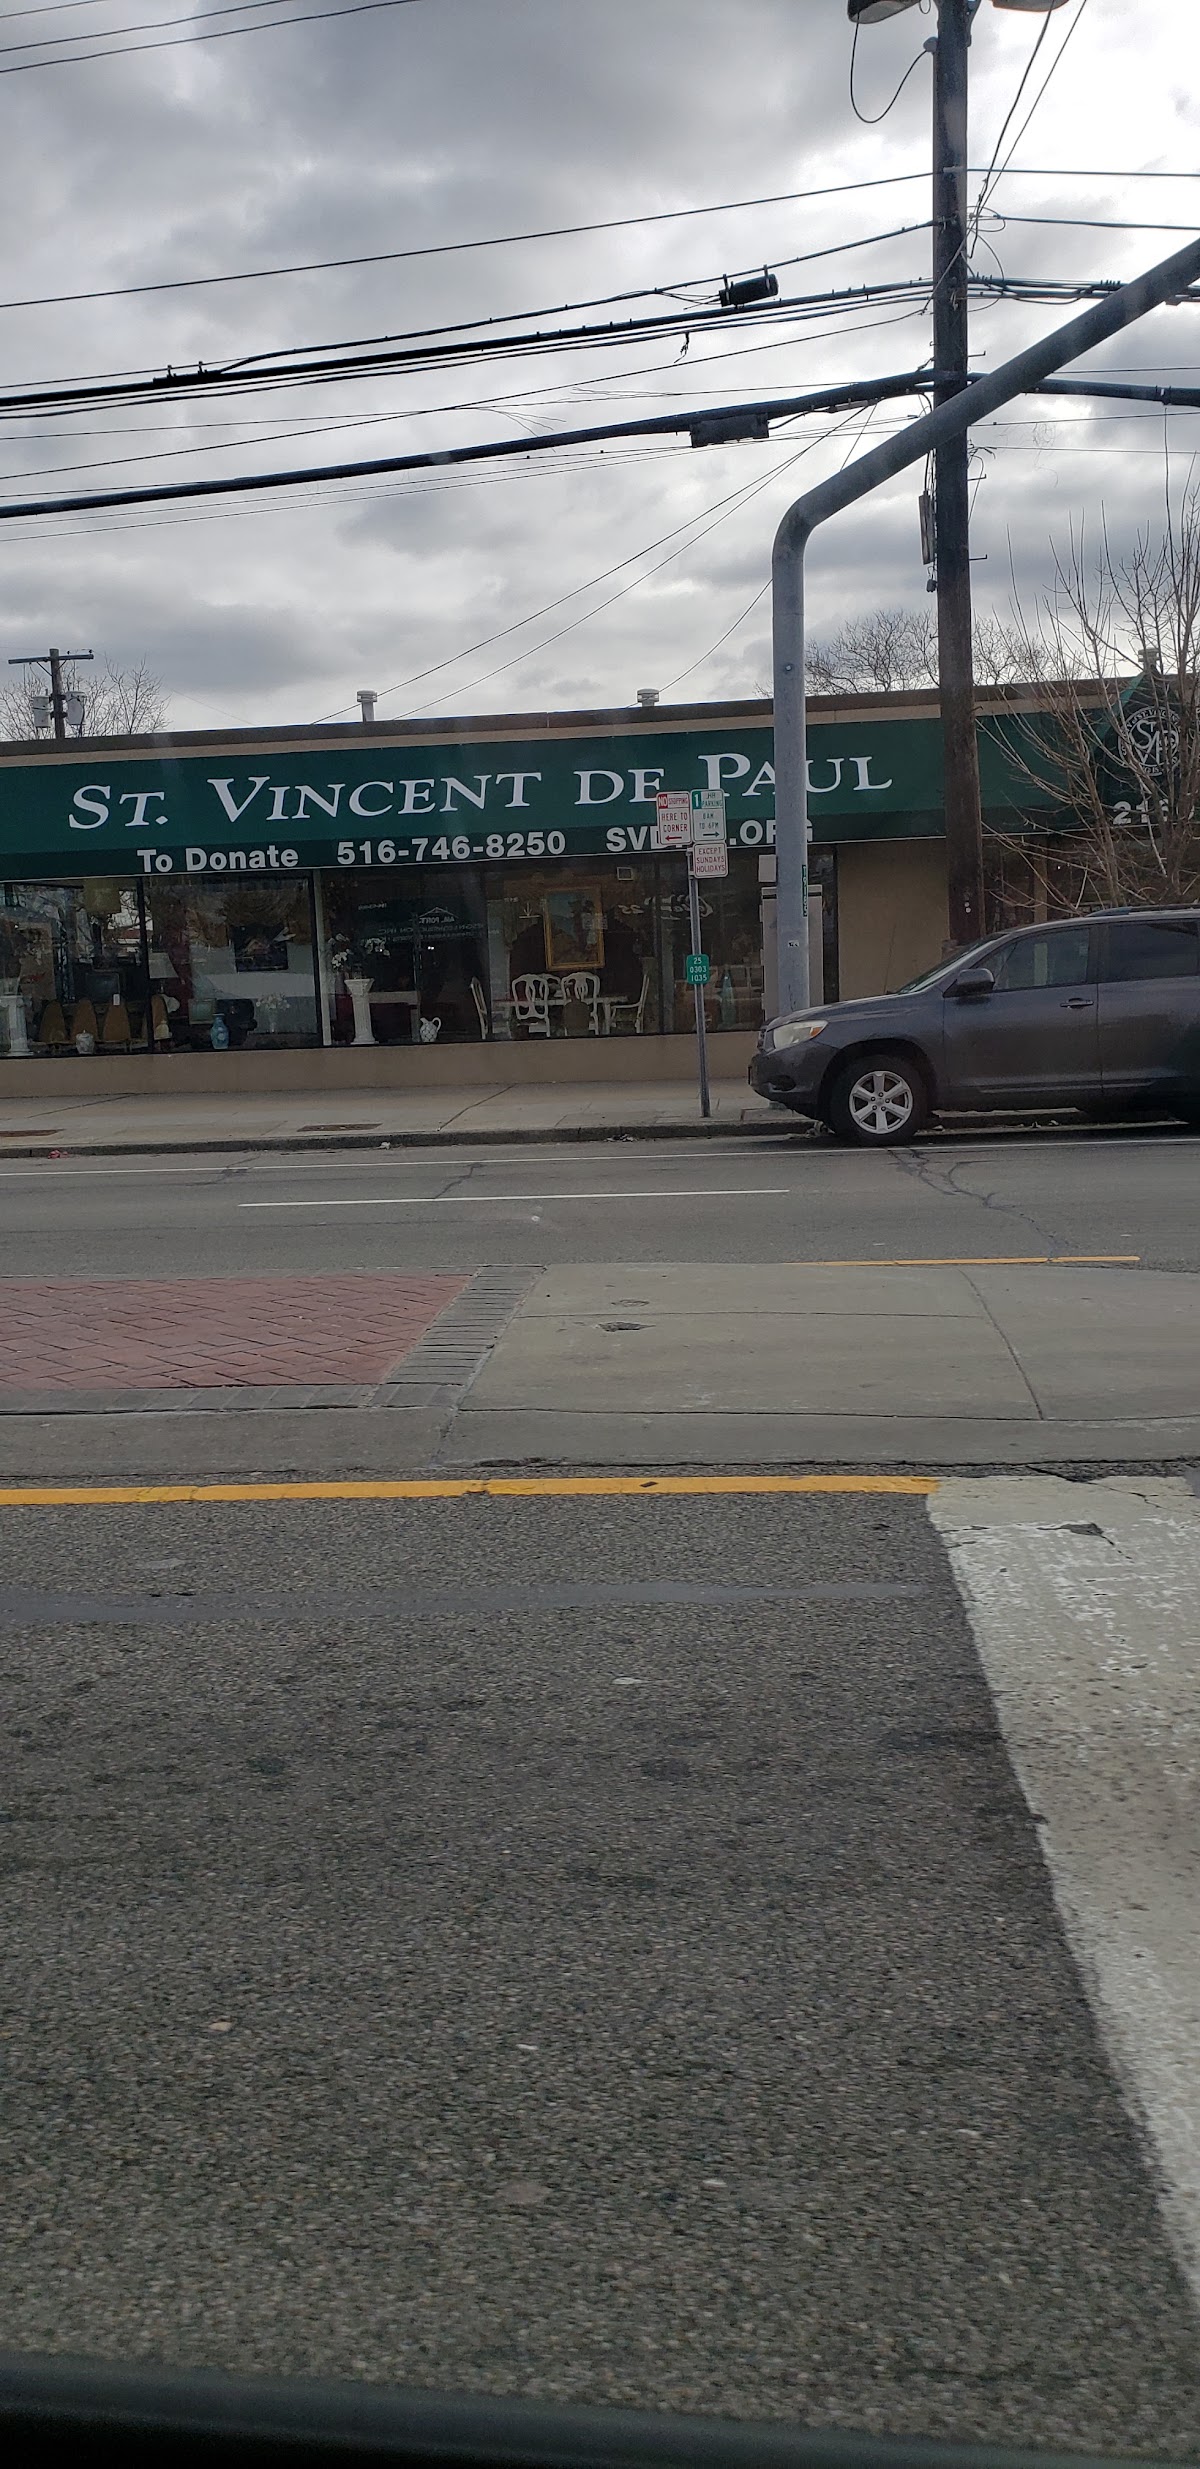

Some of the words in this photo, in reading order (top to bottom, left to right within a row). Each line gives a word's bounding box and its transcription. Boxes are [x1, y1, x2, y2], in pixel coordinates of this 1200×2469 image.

[69, 785, 169, 829] ST.
[207, 772, 542, 823] VINCENT
[573, 768, 665, 806] DE
[698, 753, 893, 798] PAUL
[658, 795, 668, 807] NO
[694, 793, 699, 807] 1
[661, 812, 677, 821] HERE
[680, 812, 688, 820] TO
[663, 824, 688, 833] CORNER
[137, 849, 173, 873] To
[186, 844, 299, 871] Donate
[337, 831, 566, 865] 516-746-8250
[698, 847, 722, 855] EXCEPT
[696, 855, 725, 864] SUNDAYS
[696, 864, 725, 873] HOLIDAYS
[693, 956, 702, 965] 25
